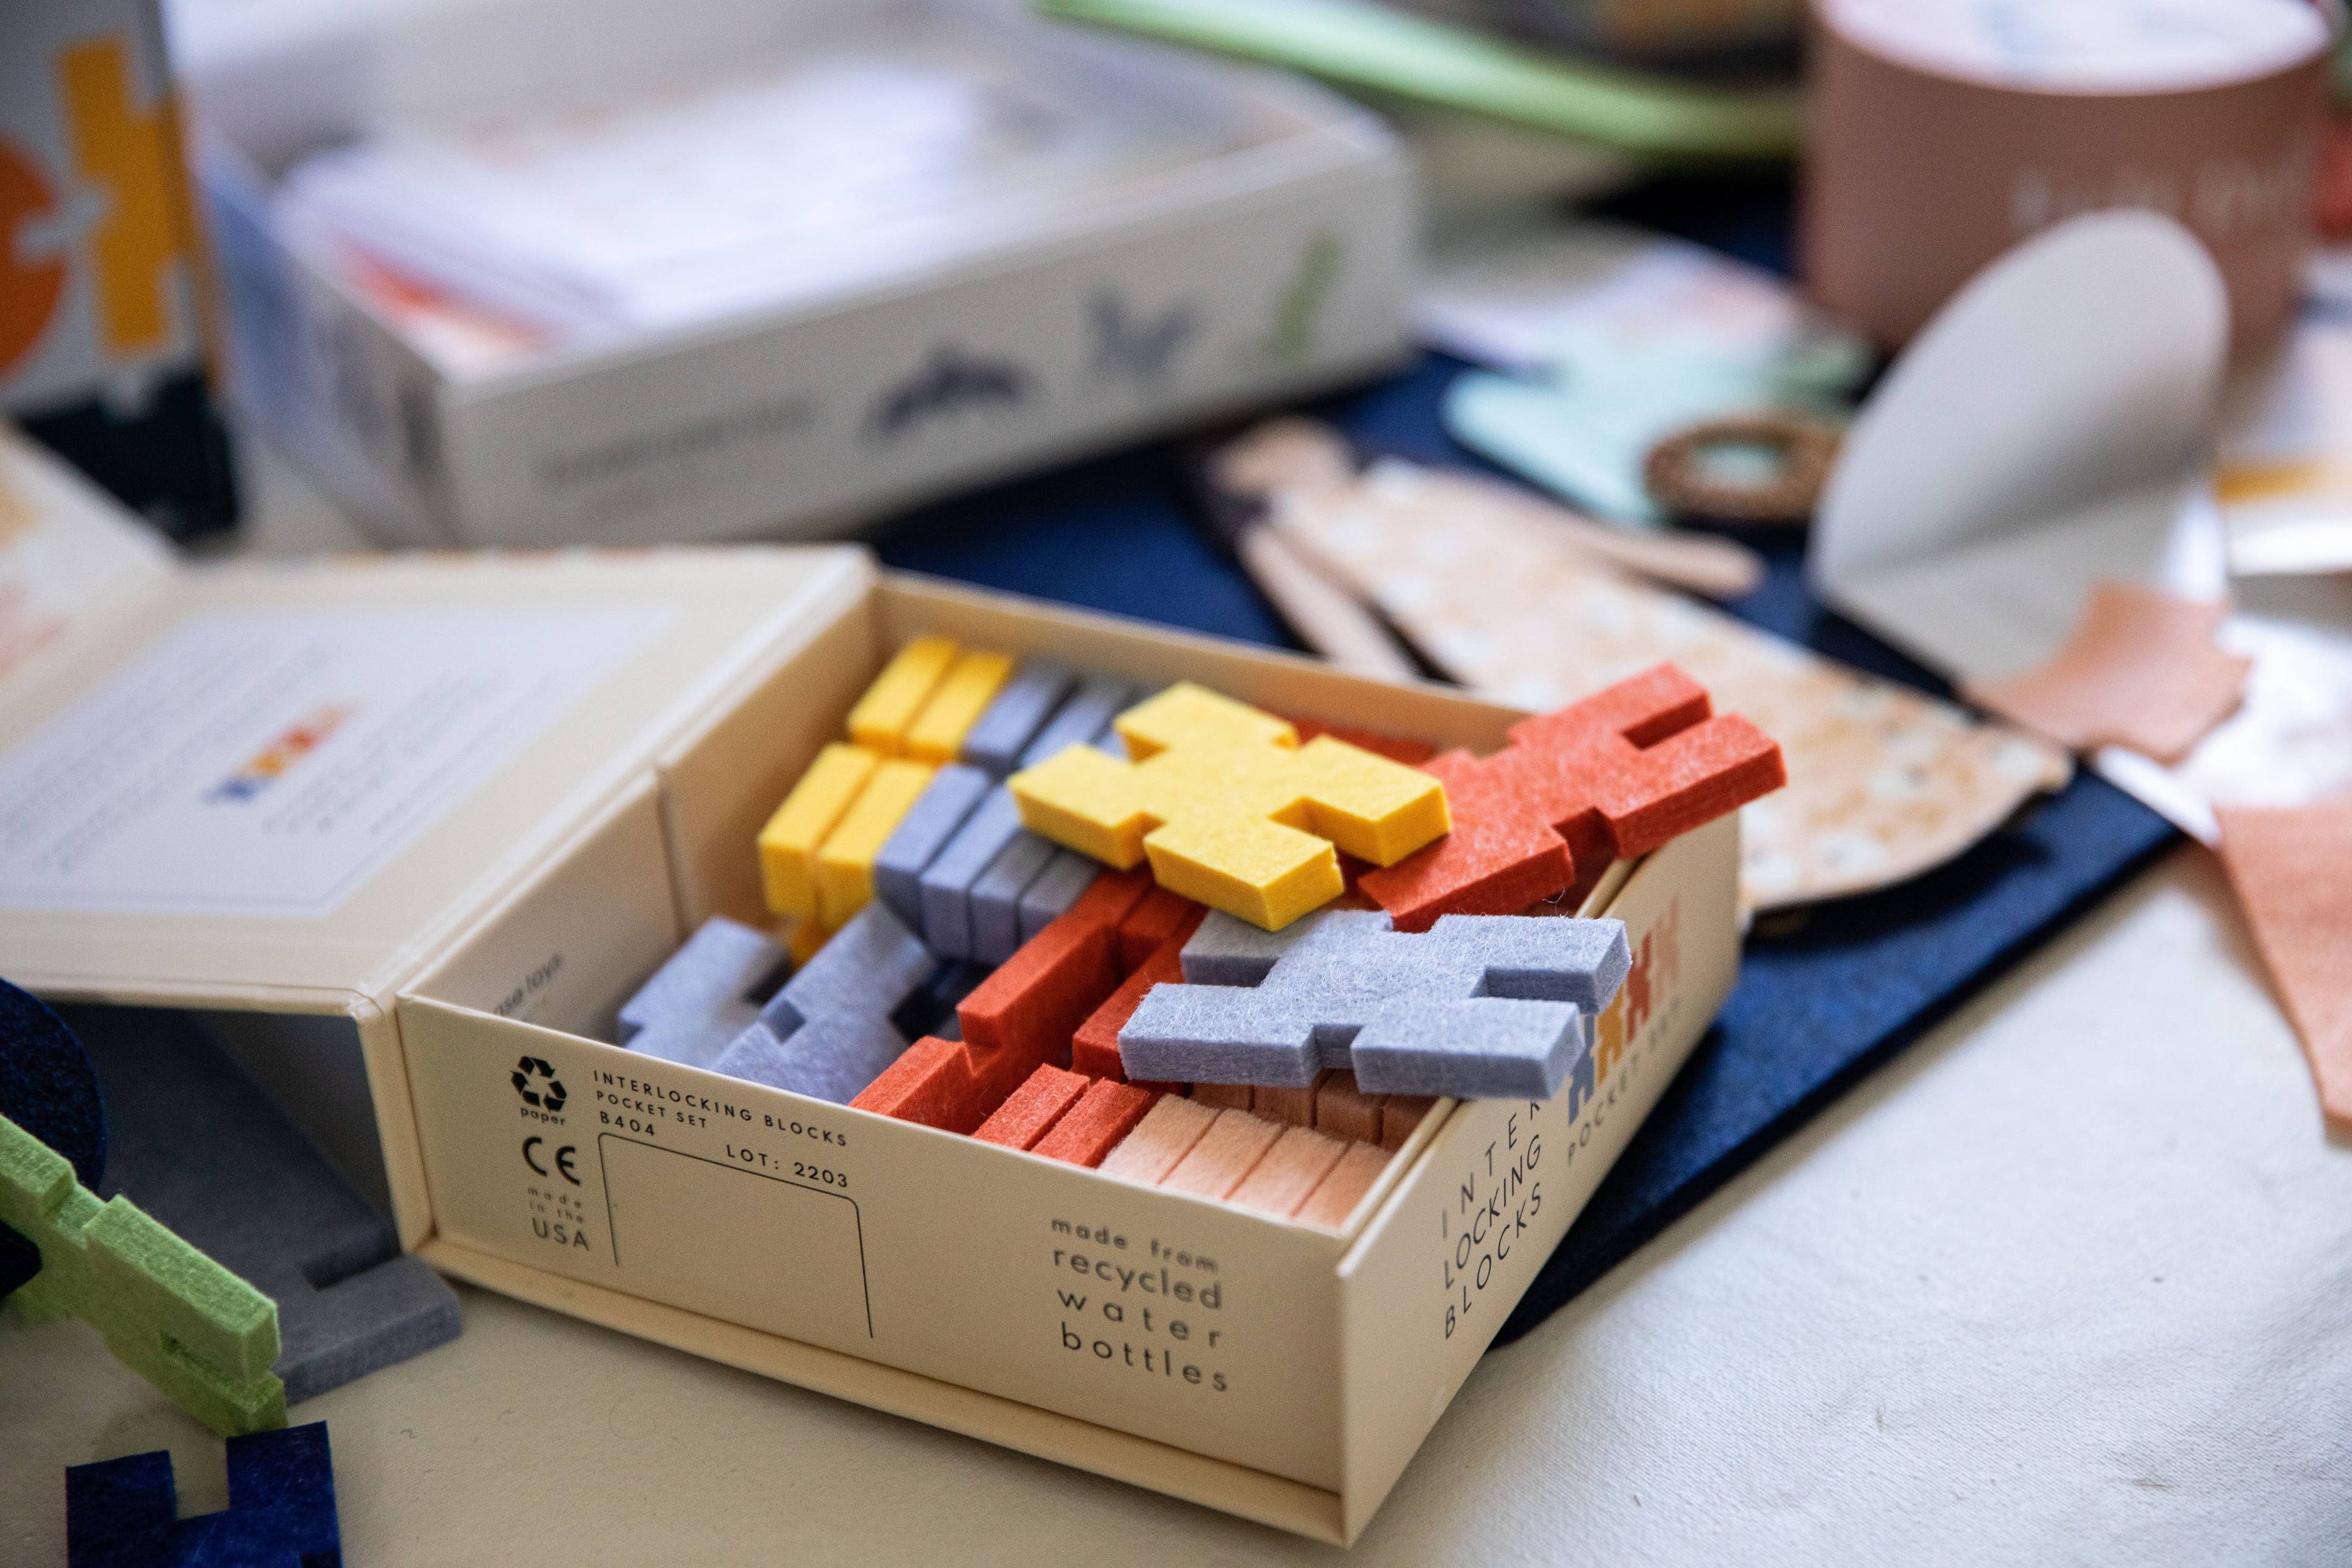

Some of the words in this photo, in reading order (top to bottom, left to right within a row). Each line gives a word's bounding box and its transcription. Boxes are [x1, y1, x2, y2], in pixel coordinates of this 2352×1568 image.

[521, 1107, 566, 1125] paper
[594, 1070, 752, 1121] INTERLOCKING
[764, 1115, 846, 1147] BLOCKS
[597, 1090, 666, 1118] POCKET
[677, 1112, 706, 1128] SET
[600, 1110, 655, 1136] B404
[522, 1136, 581, 1186] CE
[726, 1144, 778, 1170] LOT:
[794, 1161, 848, 1188] 2203
[527, 1187, 581, 1208] made
[529, 1200, 544, 1213] in
[557, 1208, 583, 1223] the
[1444, 1134, 1541, 1289] LOCKING
[532, 1217, 590, 1251] USA
[1051, 1218, 1128, 1250] made
[1150, 1237, 1219, 1273] from
[1054, 1248, 1222, 1310] recycled
[1445, 1182, 1541, 1340] BLOCKS
[1057, 1288, 1221, 1349] water
[1061, 1320, 1227, 1392] bottles
